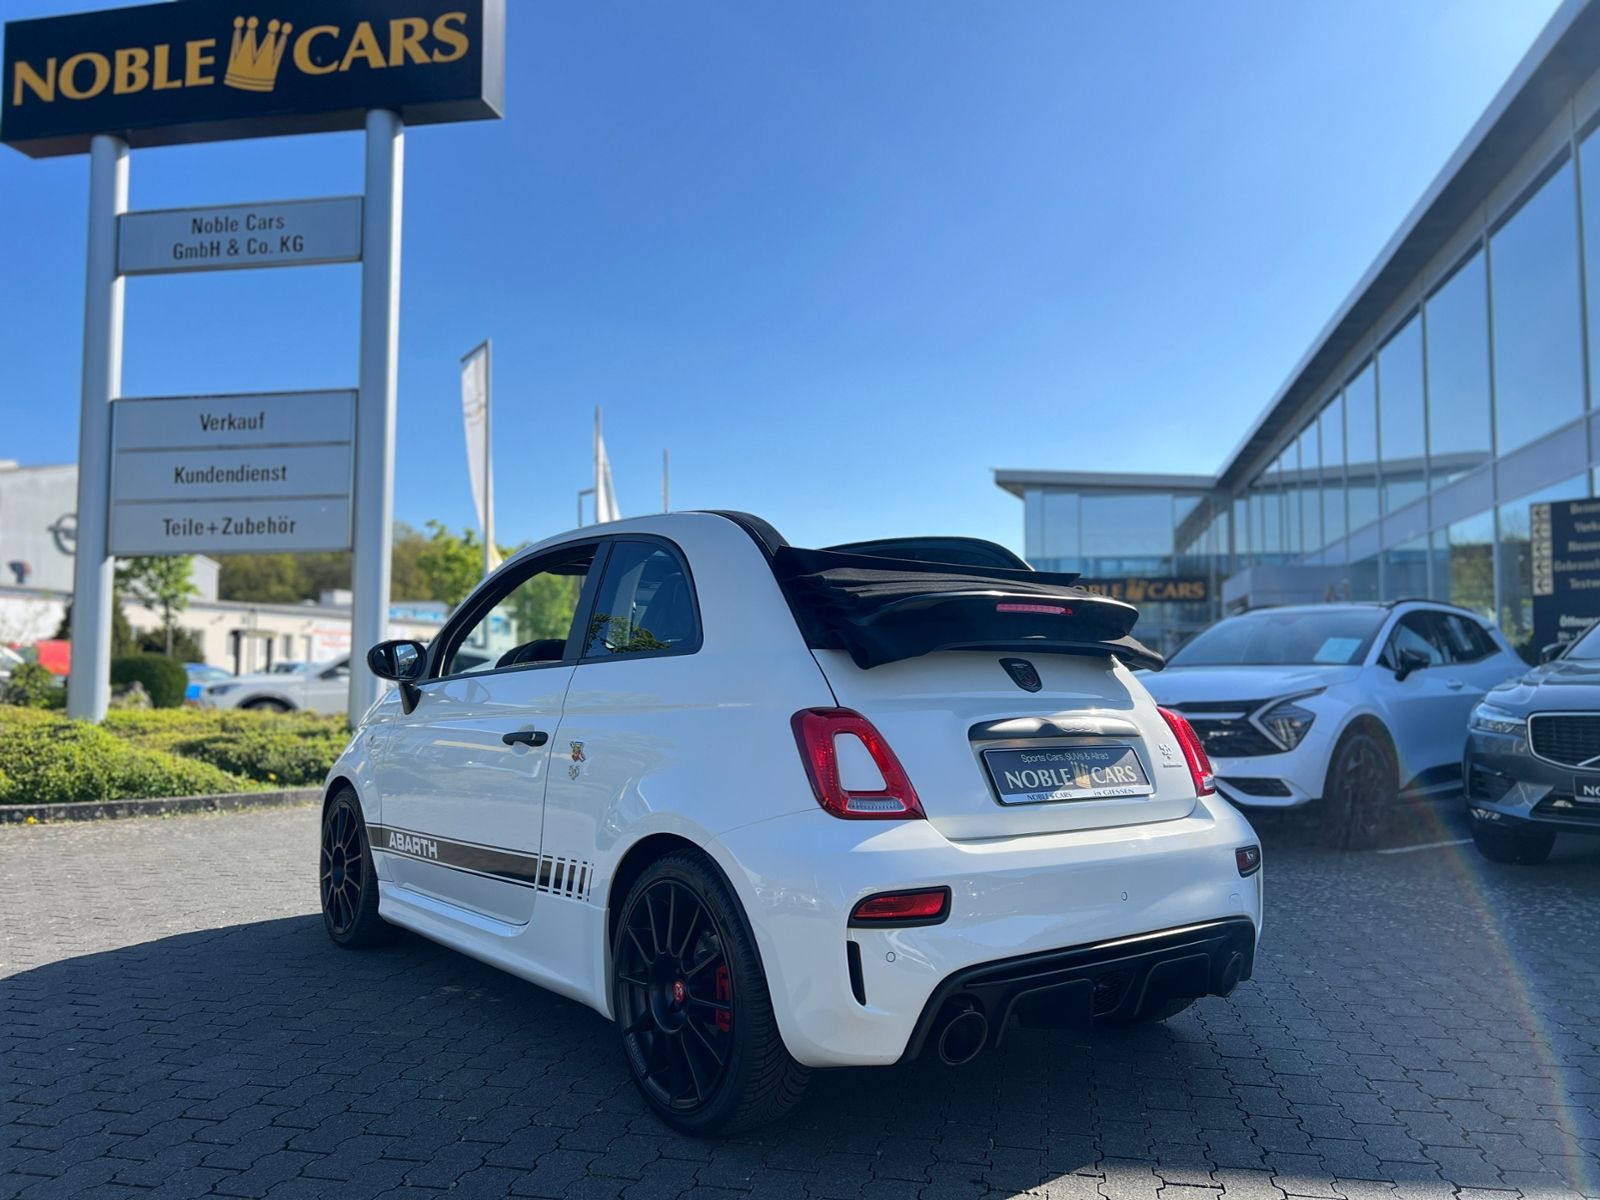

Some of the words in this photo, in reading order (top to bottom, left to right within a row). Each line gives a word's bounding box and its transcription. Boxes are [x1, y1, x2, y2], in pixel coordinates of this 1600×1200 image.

[13, 38, 216, 105] NOBLE
[293, 12, 470, 75] CARS
[191, 215, 239, 235] Noble
[246, 213, 285, 231] Cars
[173, 241, 220, 261] GmbH
[227, 239, 239, 256] &
[247, 238, 274, 256] Co.
[280, 235, 304, 253] KG
[200, 411, 265, 432] Verkauf
[174, 464, 287, 485] Kundendienst
[1148, 582, 1205, 599] CARS
[1020, 753, 1046, 764] Sports
[1064, 752, 1084, 761] SUVs
[1004, 767, 1074, 790] NOBLE
[1091, 765, 1138, 784] CARS
[389, 831, 438, 860] ABARTH
